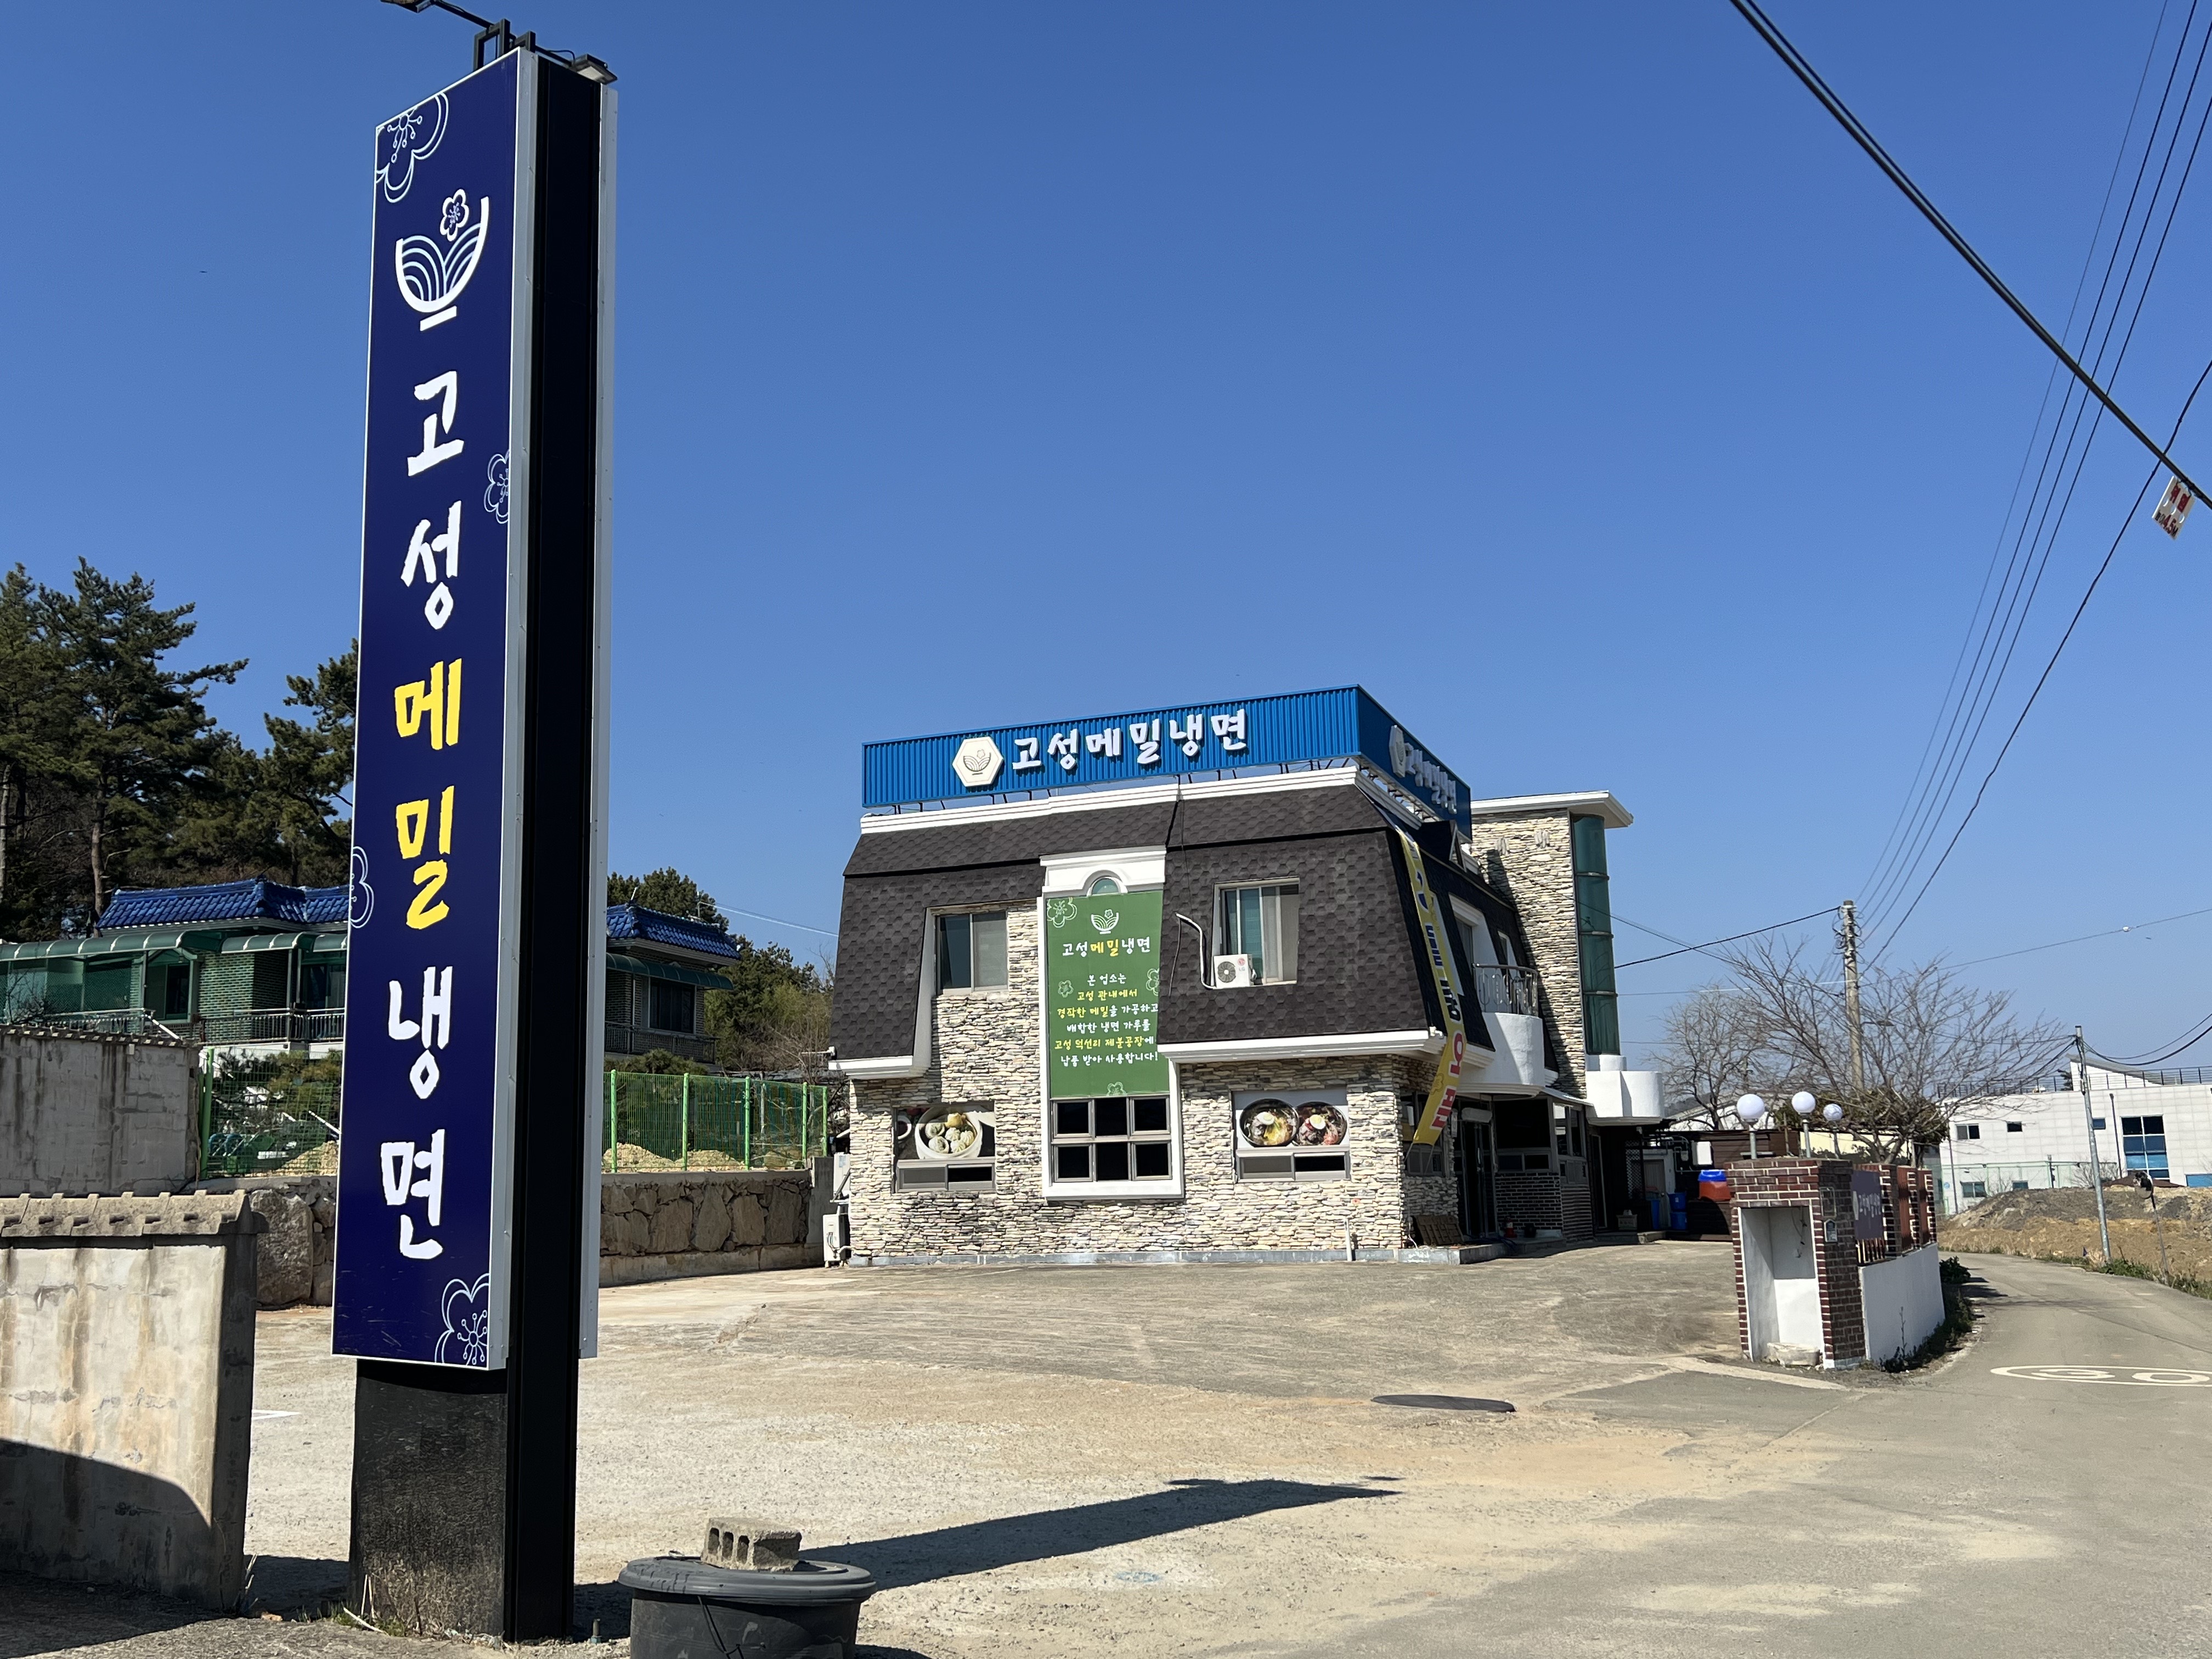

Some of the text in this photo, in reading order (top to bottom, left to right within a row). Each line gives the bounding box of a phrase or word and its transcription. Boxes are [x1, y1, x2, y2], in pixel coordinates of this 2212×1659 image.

[1012, 708, 1248, 771] 고성메밀냉면
[381, 371, 464, 1259] 고성메밀냉면
[1062, 936, 1150, 957] 고성메밀냉면
[1087, 973, 1127, 986] 본 업소는
[1077, 988, 1137, 1002] 고성 관내에서
[1057, 1003, 1159, 1019] 경작한 메밀을 가공하고
[1066, 1019, 1151, 1034] 배합한 냉면 가루를
[1054, 1039, 1071, 1051] 고성
[1105, 1035, 1154, 1049] 제분공장에
[1060, 1051, 1159, 1068] 납품 받아 사용합니다!
[2031, 1368, 2210, 1384] 30
